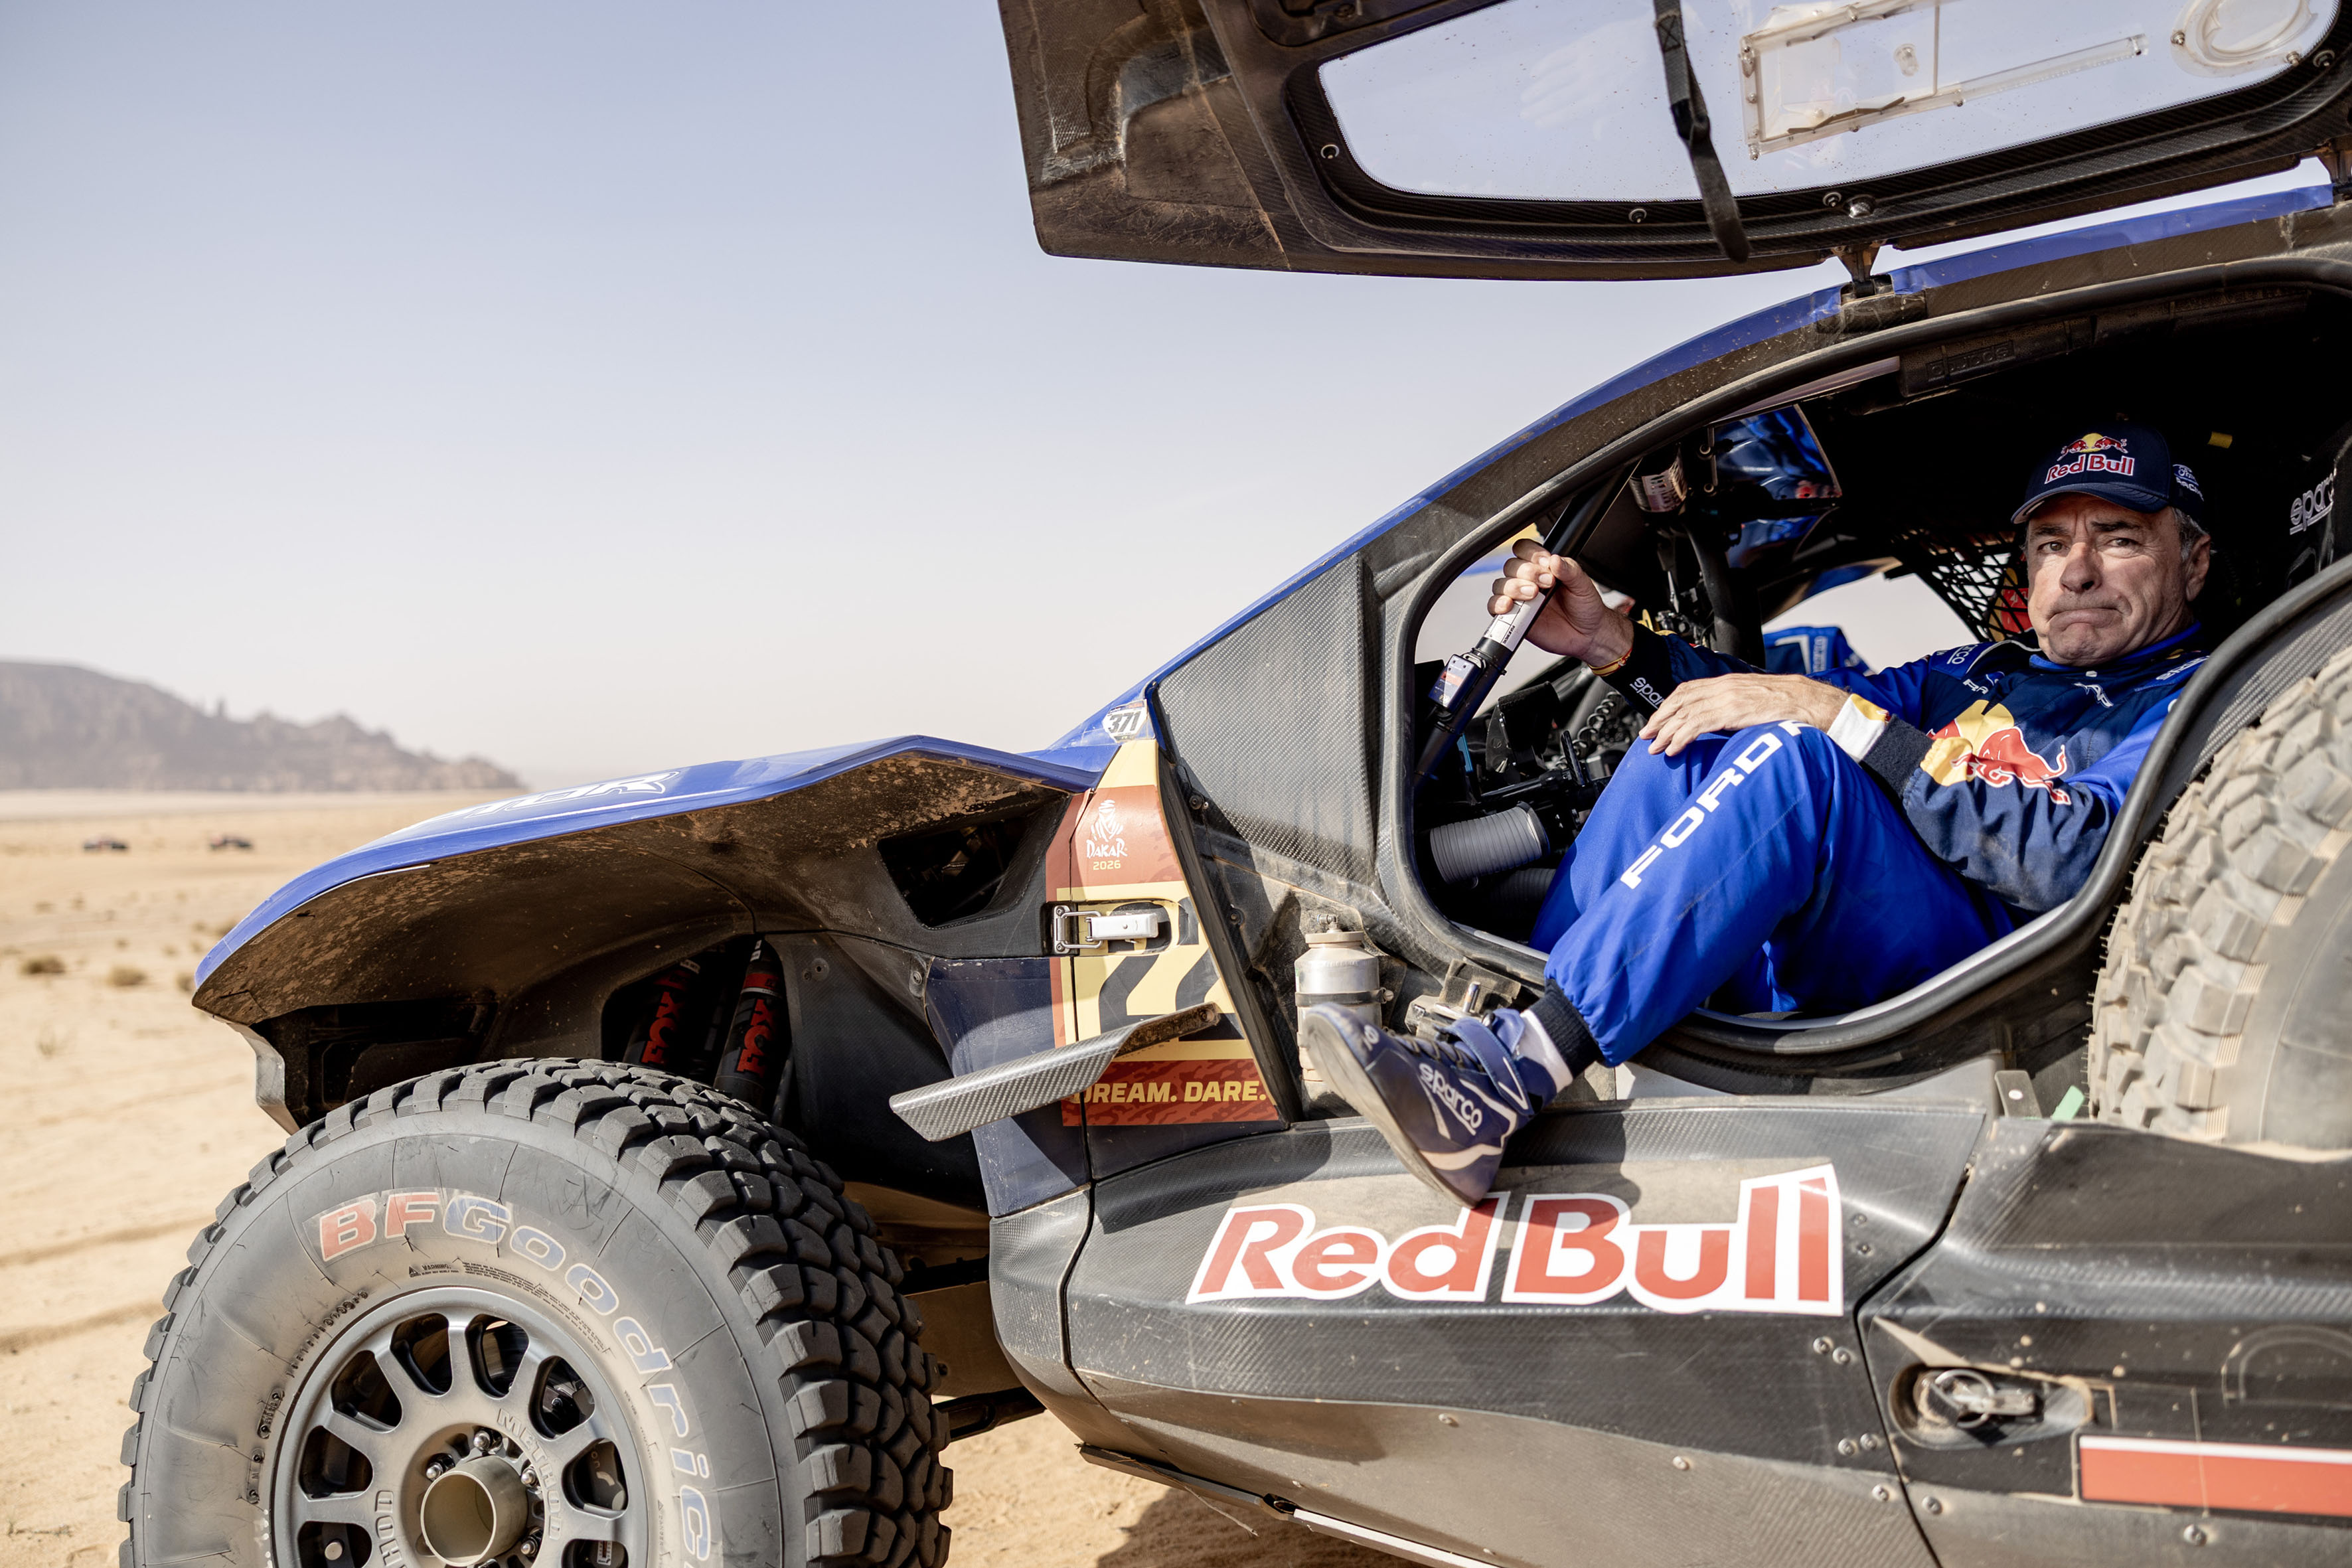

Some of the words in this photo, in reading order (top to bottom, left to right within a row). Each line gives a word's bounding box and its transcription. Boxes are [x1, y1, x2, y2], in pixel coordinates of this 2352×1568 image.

[2046, 455, 2085, 483] Red
[2088, 454, 2134, 476] Bull
[1107, 711, 1141, 734] 371
[1620, 732, 1783, 890] FORD
[1086, 838, 1128, 859] DAKAR
[1093, 860, 1121, 870] 2026
[641, 991, 682, 1065] FOX
[736, 998, 775, 1077] FOX
[1184, 1081, 1267, 1102] DARE.
[1419, 1063, 1482, 1130] sparco
[1194, 1195, 1504, 1298] Red
[1508, 1171, 1835, 1308] Bull
[317, 1190, 711, 1568] BFGoodric
[497, 1408, 562, 1540] METHOD
